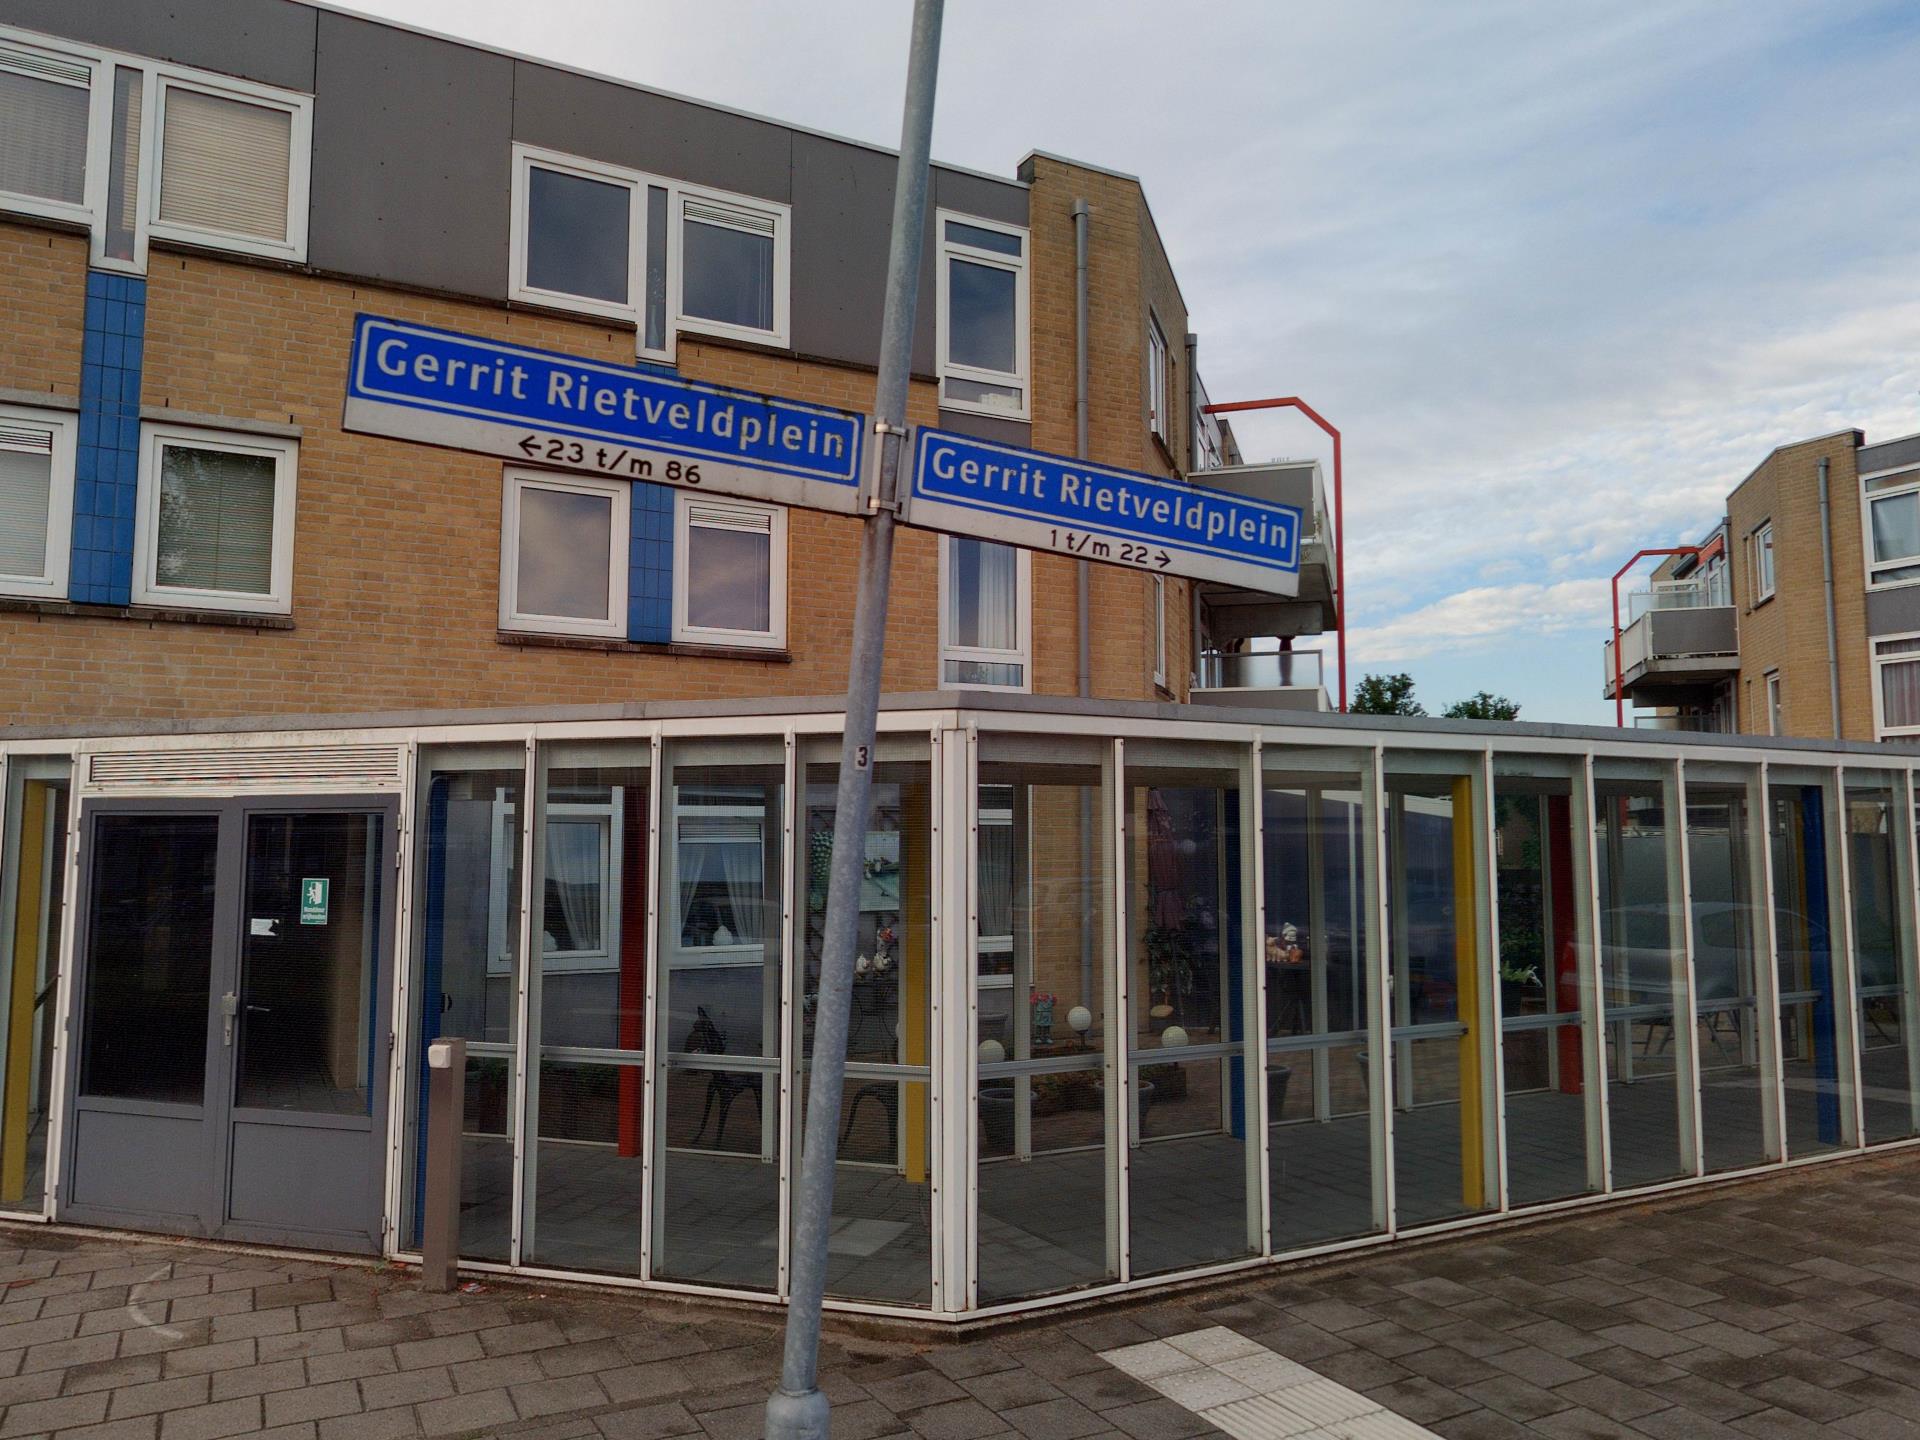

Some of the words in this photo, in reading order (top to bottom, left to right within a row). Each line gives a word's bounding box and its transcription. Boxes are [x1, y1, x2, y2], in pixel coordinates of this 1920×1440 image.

[376, 338, 529, 400] Gerrit
[546, 370, 844, 460] Rietveldplein
[546, 439, 584, 464] 23
[596, 448, 652, 476] t/m
[665, 460, 701, 484] 86
[932, 447, 1047, 498] Gerrit
[1060, 473, 1288, 549] Rietveldplein
[1050, 529, 1057, 547] 1
[1066, 532, 1110, 557] t/m
[1119, 543, 1149, 564] 22
[857, 746, 868, 767] 3
